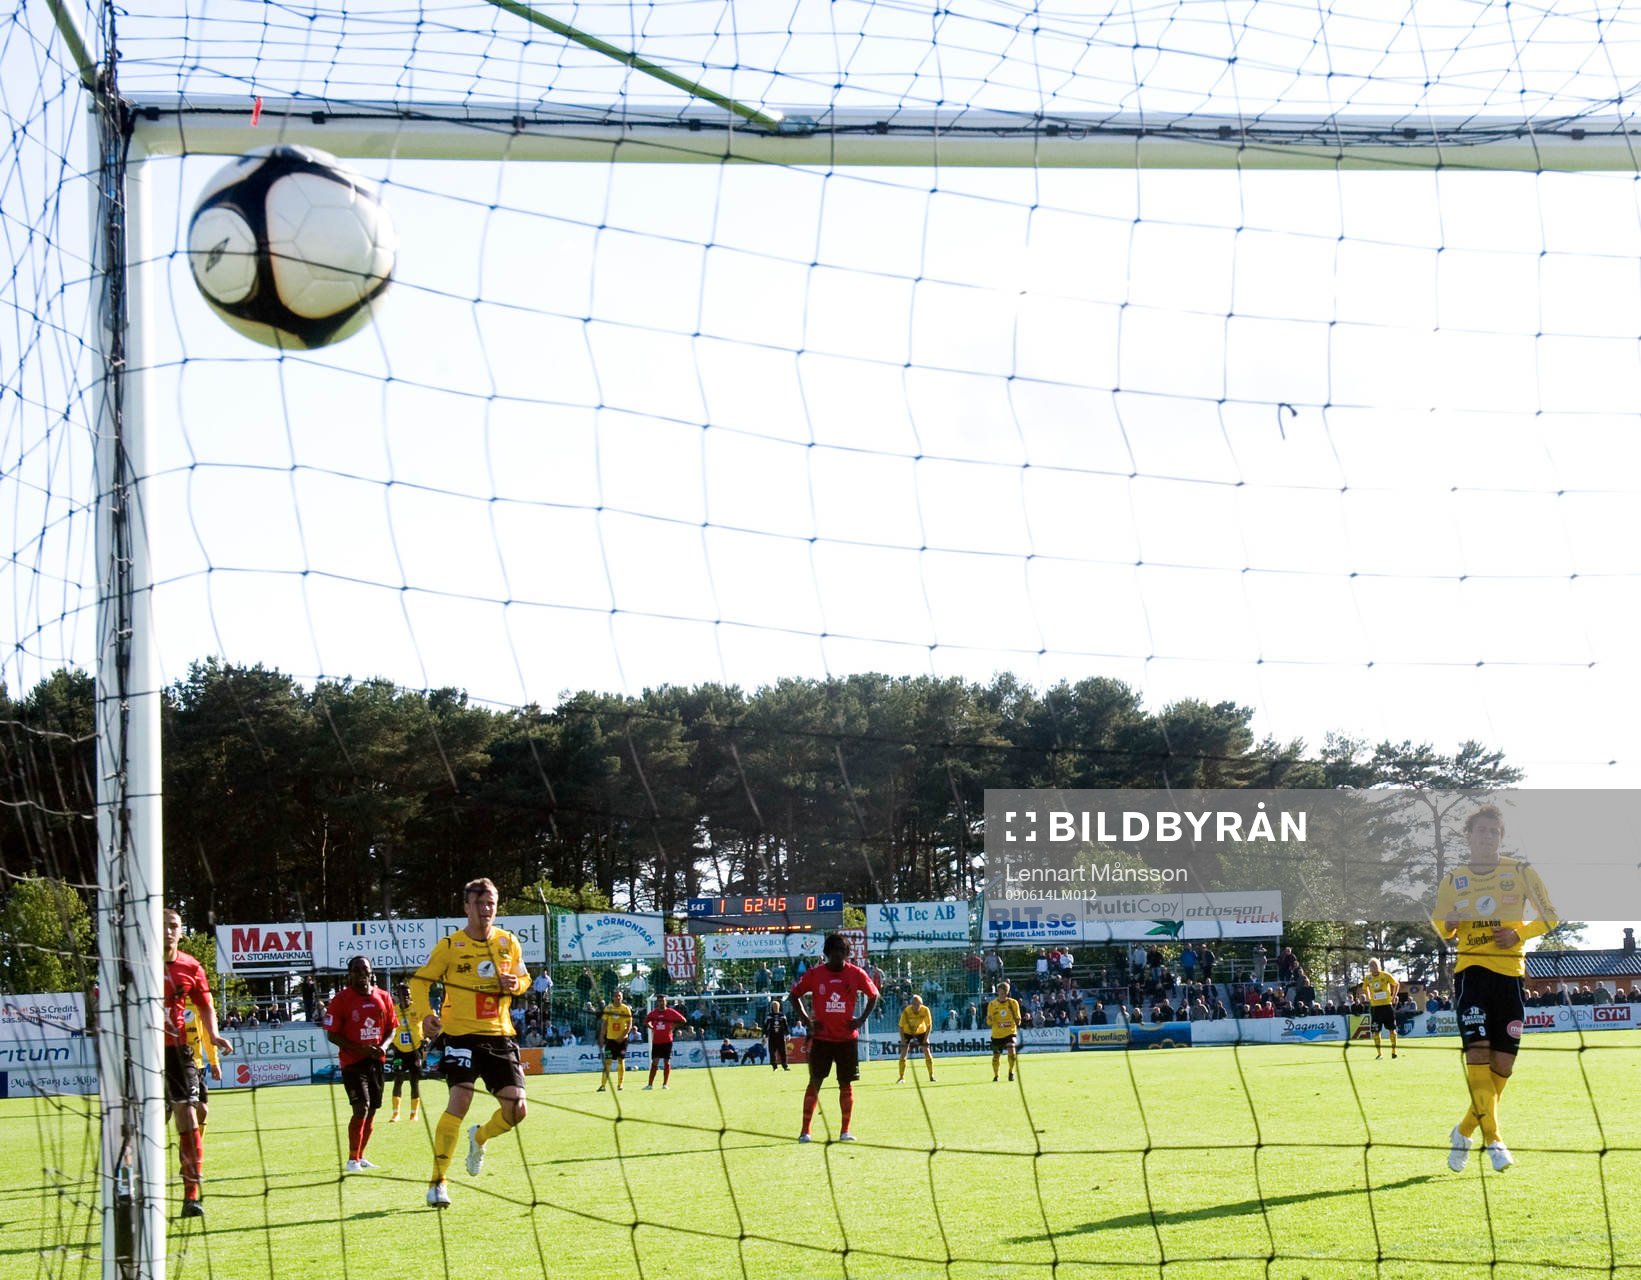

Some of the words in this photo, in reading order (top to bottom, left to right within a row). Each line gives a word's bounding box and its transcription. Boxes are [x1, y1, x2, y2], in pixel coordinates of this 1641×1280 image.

[689, 903, 706, 911] SAS
[719, 899, 725, 913] 1
[743, 898, 787, 912] 62:45
[806, 896, 815, 911] 0
[819, 898, 836, 907] SAS
[1085, 898, 1179, 917] MultiCopy
[880, 907, 900, 921] SR
[905, 906, 929, 921] Tec
[935, 905, 956, 920] AB
[1185, 905, 1263, 917] ottosson
[1236, 911, 1280, 924] truck
[989, 906, 1077, 931] BLT.se
[369, 922, 425, 935] SVENSK
[338, 938, 426, 951] FASTIGHETS
[666, 936, 695, 951] SYD
[247, 951, 313, 961] STORMARKNAD
[1524, 1012, 1555, 1027] mix
[1595, 1007, 1628, 1020] GYM
[1283, 1018, 1337, 1034] Dagmars
[1478, 1026, 1486, 1037] 9
[231, 1034, 318, 1056] PreFast
[253, 1063, 291, 1073] Lyckeby
[457, 1058, 472, 1068] 70
